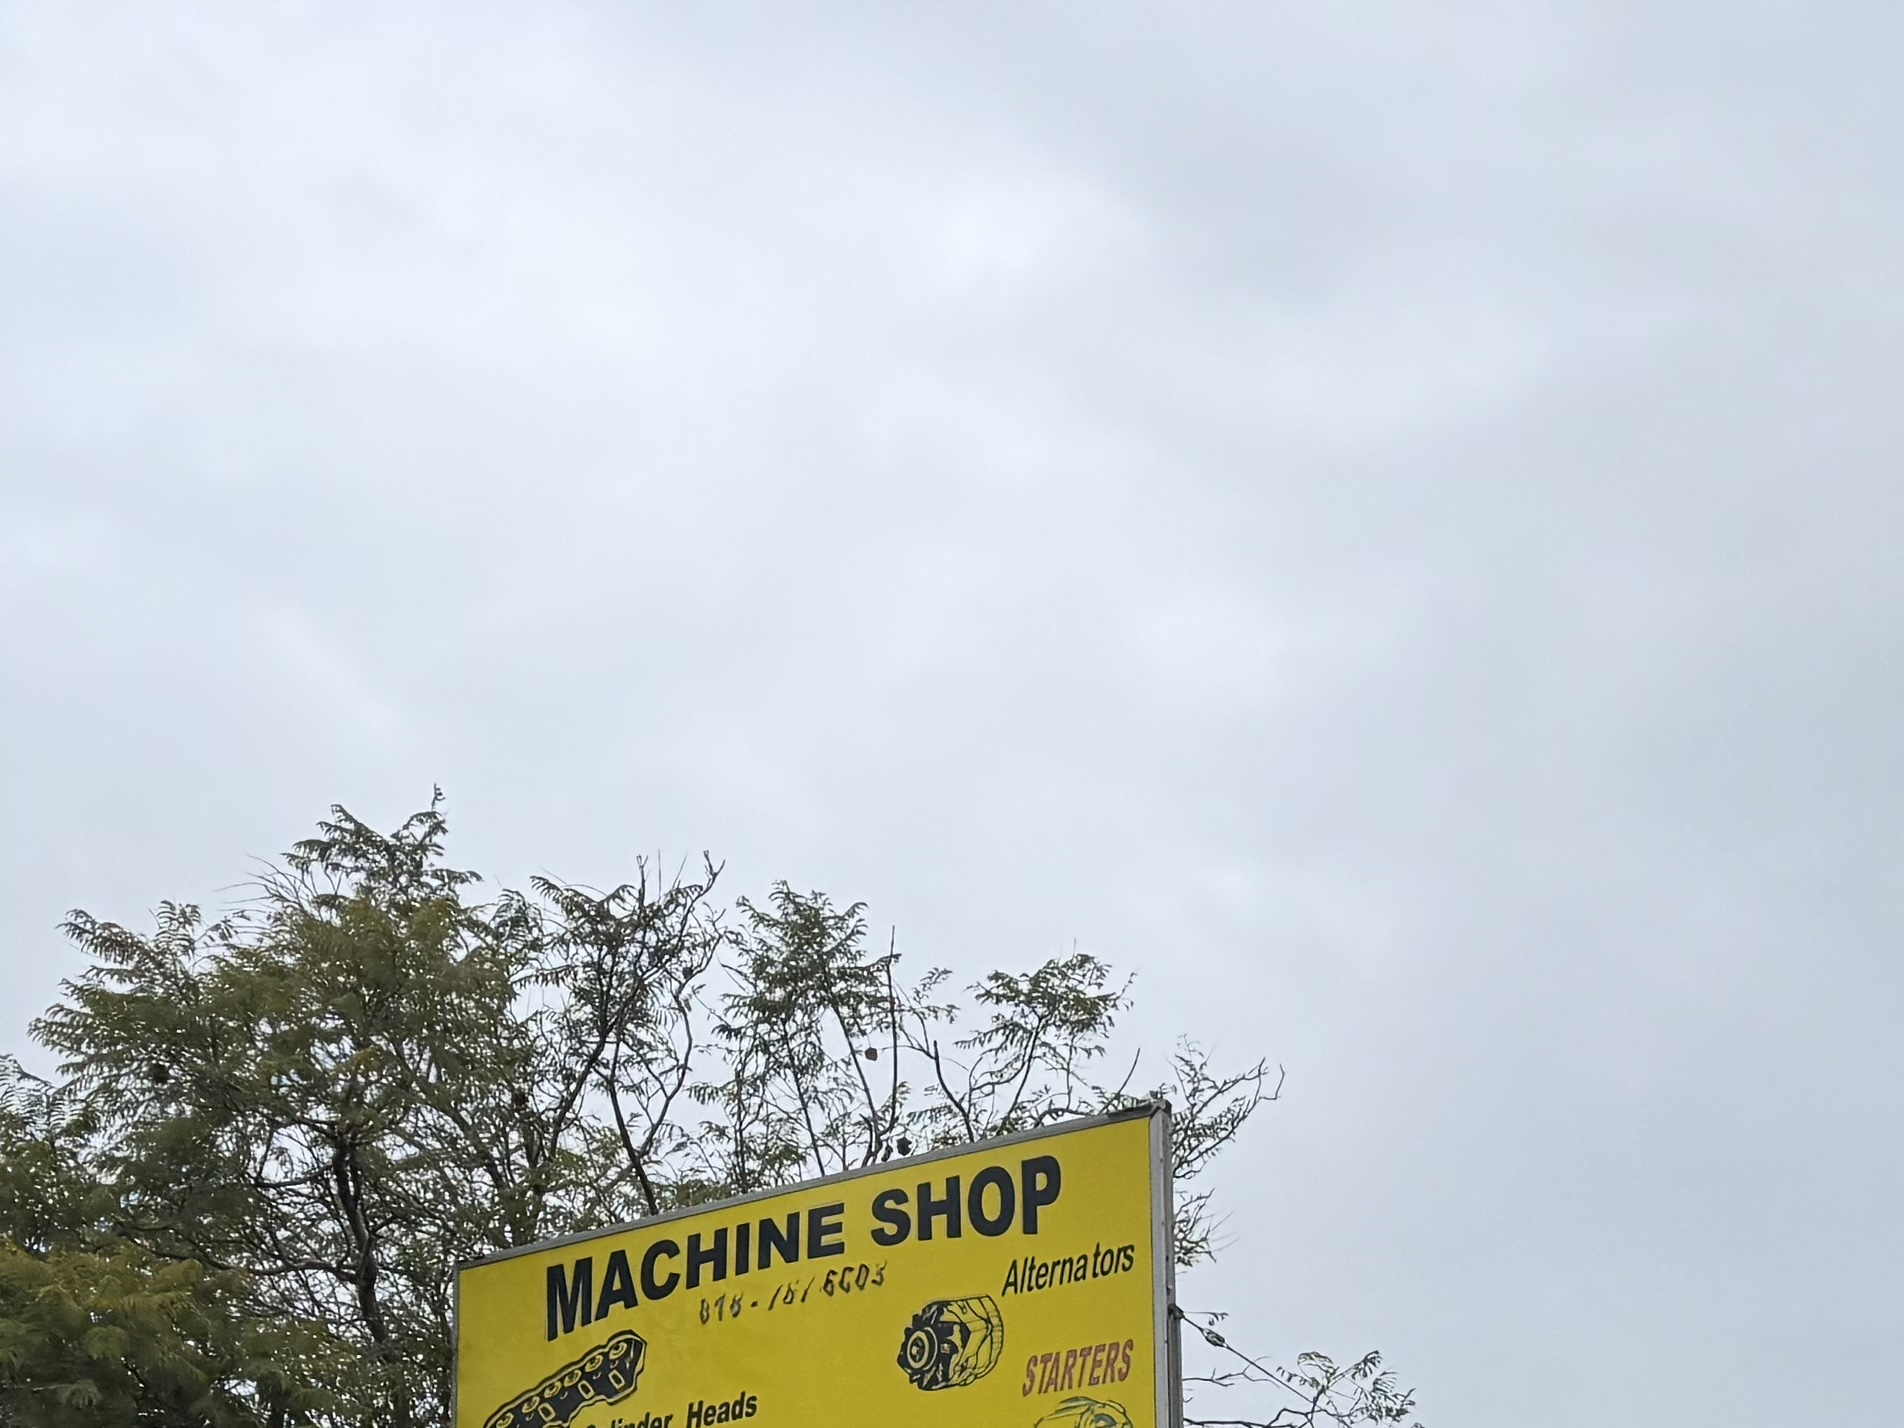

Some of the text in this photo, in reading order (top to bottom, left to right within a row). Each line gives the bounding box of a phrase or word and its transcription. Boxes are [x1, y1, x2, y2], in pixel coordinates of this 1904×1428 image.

[546, 1155, 1061, 1341] MACHINE SHOP
[1001, 1241, 1136, 1297] Alternators
[1022, 1337, 1134, 1397] STARTERS
